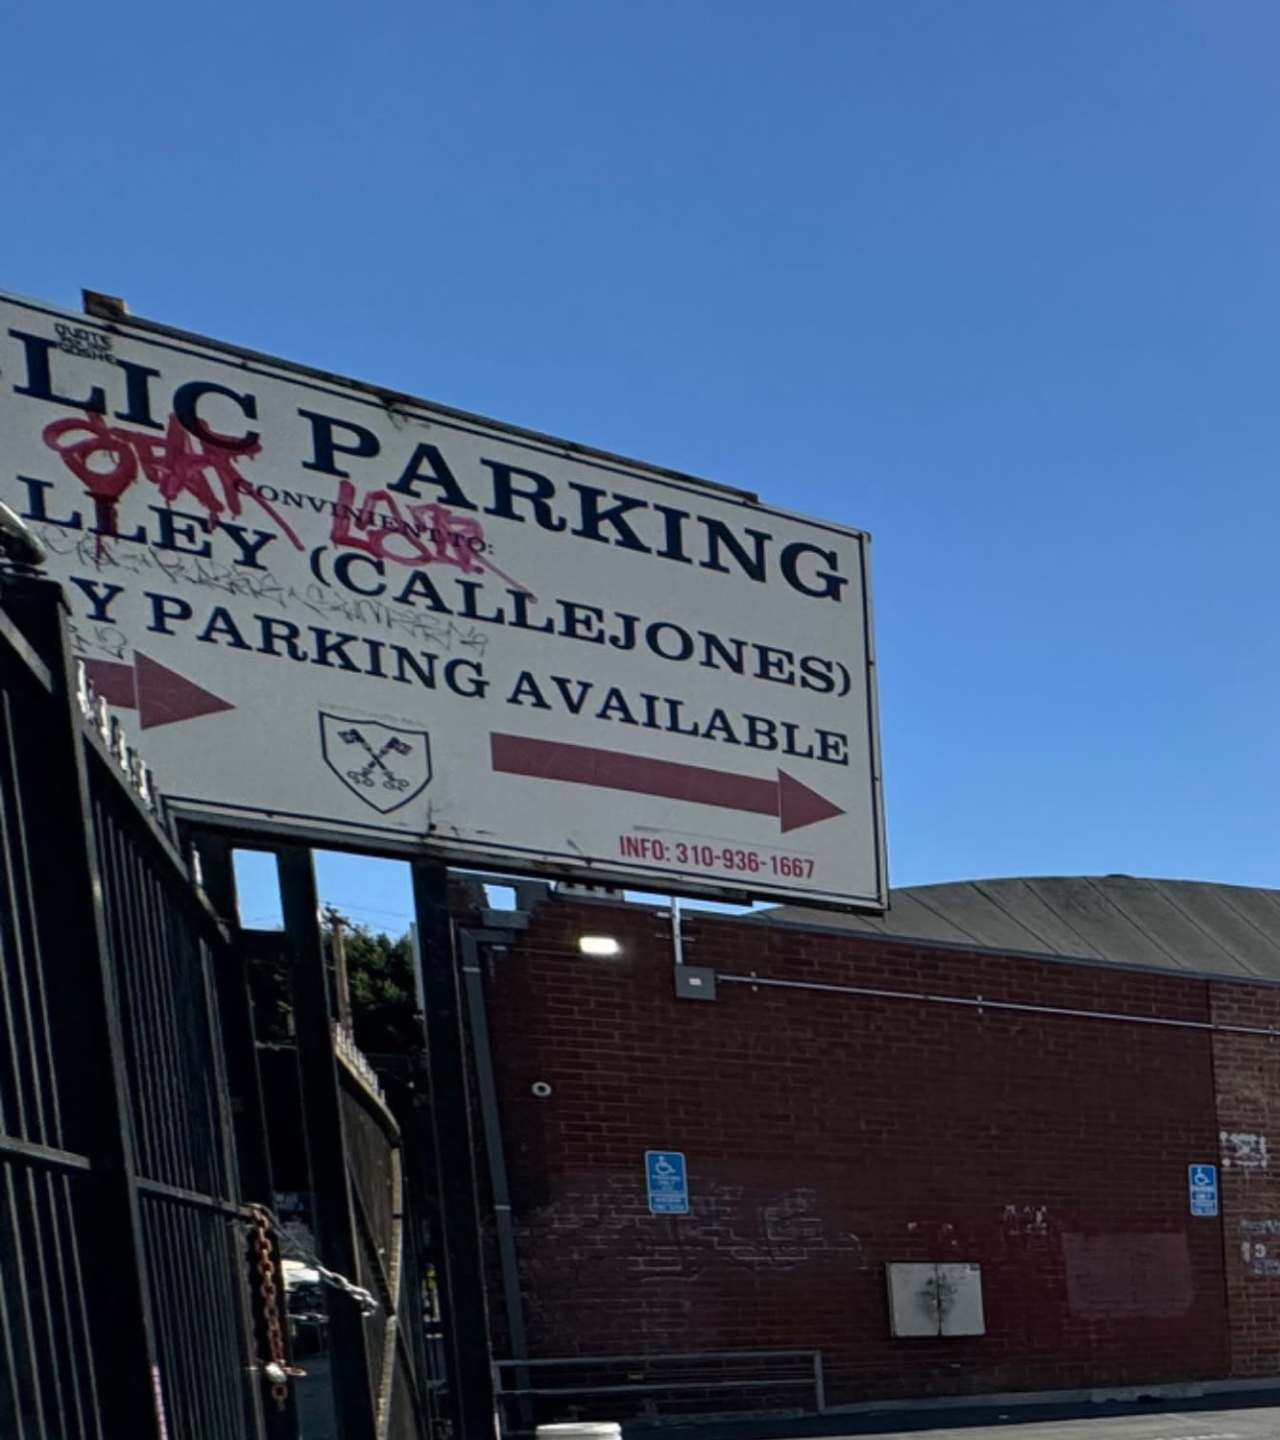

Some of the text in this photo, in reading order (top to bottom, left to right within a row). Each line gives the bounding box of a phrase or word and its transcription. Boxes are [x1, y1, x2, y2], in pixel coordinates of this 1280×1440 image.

[8, 328, 261, 451] LIC
[297, 408, 849, 602] PARKING
[17, 475, 277, 571] LLEY
[310, 546, 851, 697] (CALLEJONES)
[144, 591, 490, 699] PARKING
[506, 670, 849, 766] AVAILABLE
[619, 835, 815, 880] INFO: 310-936-1667
